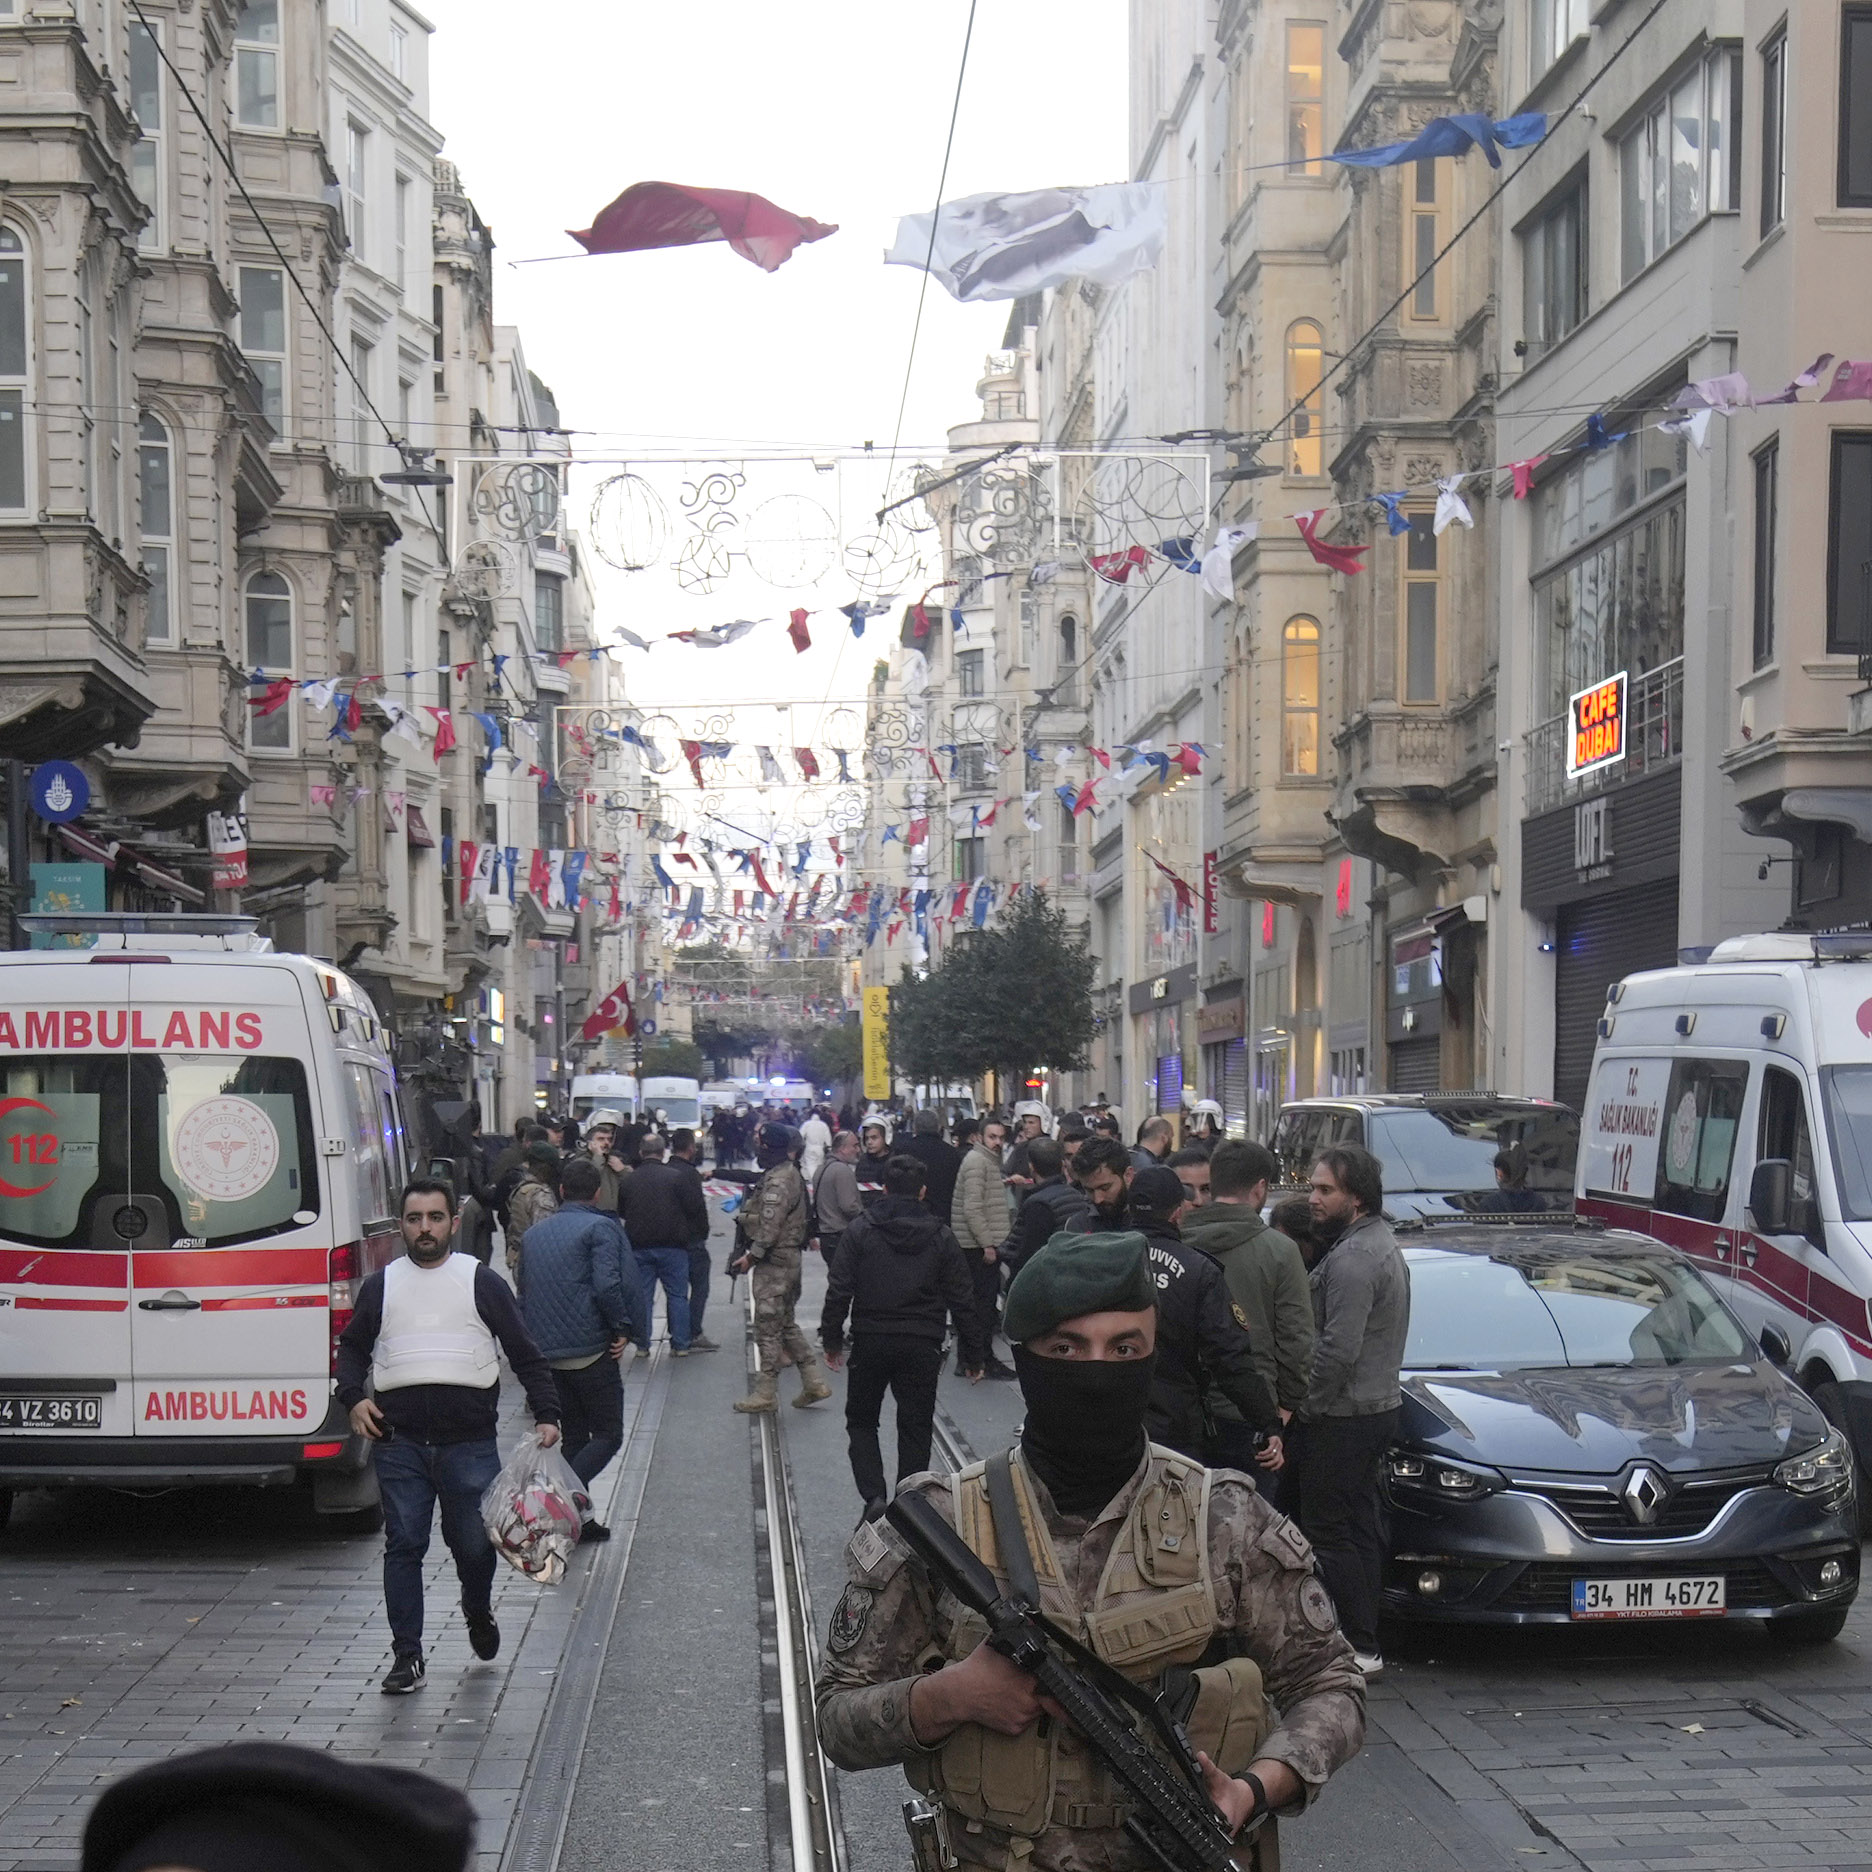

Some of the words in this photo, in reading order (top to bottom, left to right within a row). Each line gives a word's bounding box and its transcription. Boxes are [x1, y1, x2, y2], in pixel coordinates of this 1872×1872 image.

[1579, 681, 1618, 729] CAFE
[1575, 717, 1620, 768] DUBAI
[1599, 1098, 1623, 1133] SAĞLIK
[1621, 1101, 1659, 1138] BAKANLIĞI
[6, 1133, 59, 1165] 112
[1611, 1142, 1633, 1192] 112
[1149, 1247, 1186, 1279] UVVET
[19, 1400, 44, 1420] VZ
[48, 1400, 97, 1421] 3610
[144, 1389, 309, 1421] AMBULANS
[1575, 1598, 1585, 1606] TR
[1587, 1584, 1614, 1608] 34
[1626, 1583, 1653, 1607] HM
[1665, 1581, 1719, 1606] 4672
